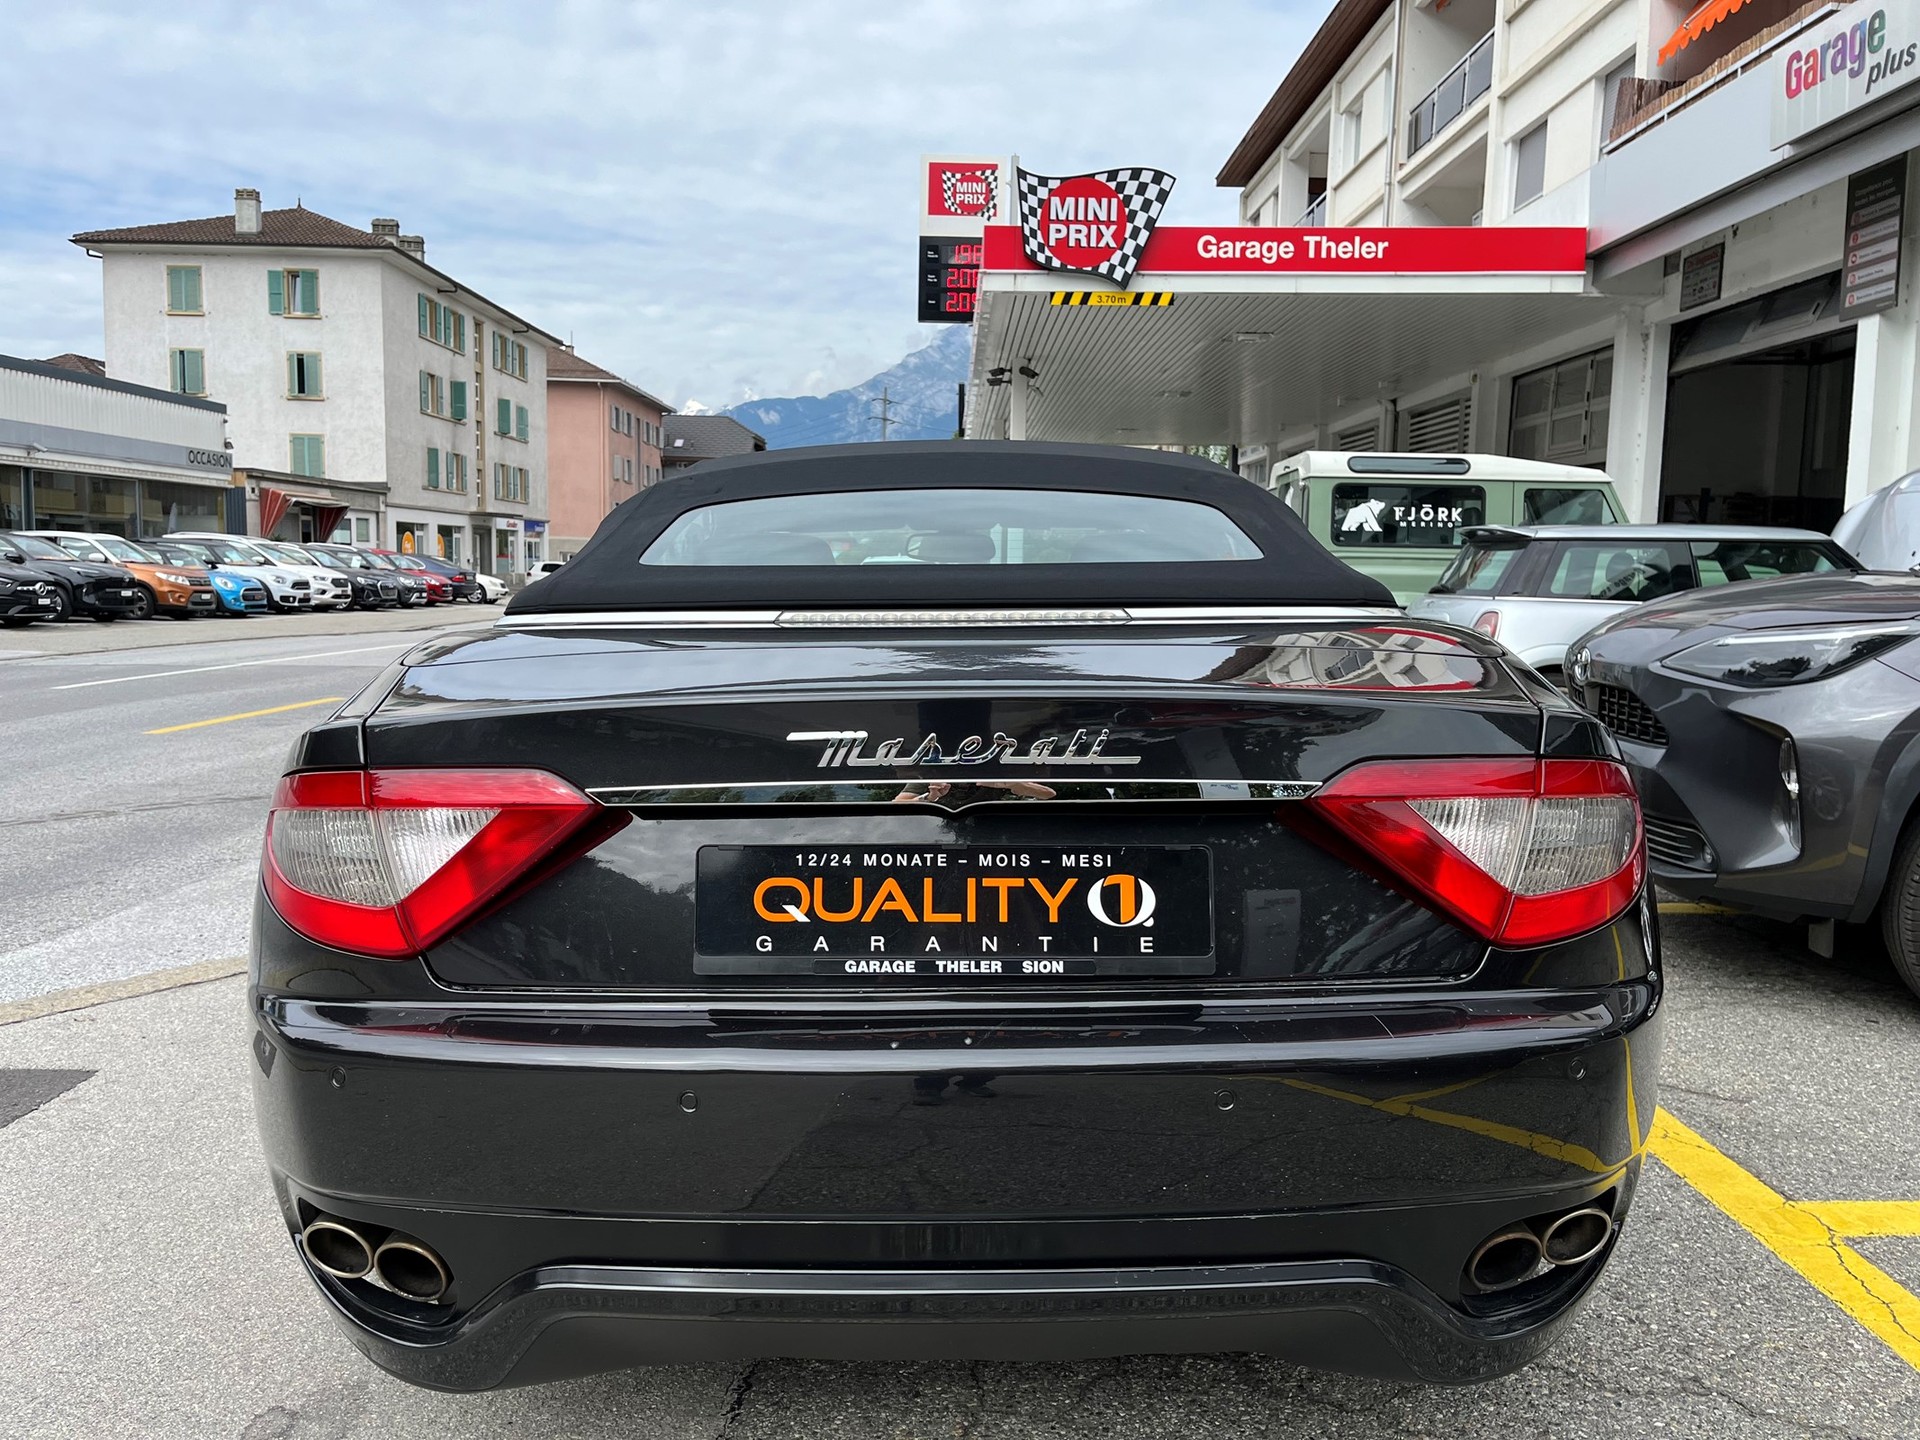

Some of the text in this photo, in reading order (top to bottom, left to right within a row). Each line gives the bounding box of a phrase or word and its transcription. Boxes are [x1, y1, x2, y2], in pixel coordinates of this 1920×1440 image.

[1786, 9, 1886, 99] Garage
[1865, 42, 1917, 95] plus
[956, 182, 986, 193] MINI
[956, 194, 987, 205] PRIX
[1049, 196, 1118, 221] MINI
[1048, 223, 1118, 248] PRIX
[1197, 235, 1389, 264] Garage Theler
[786, 728, 1142, 768] Maserati
[795, 853, 852, 867] 12/24
[863, 853, 947, 867] MONATE
[978, 853, 1031, 867] MOIS
[1061, 854, 1112, 868] MESI
[753, 876, 1079, 923] QUALITY
[755, 935, 1154, 953] GARANTIE
[844, 961, 1064, 974] GARAGE THELER SION
